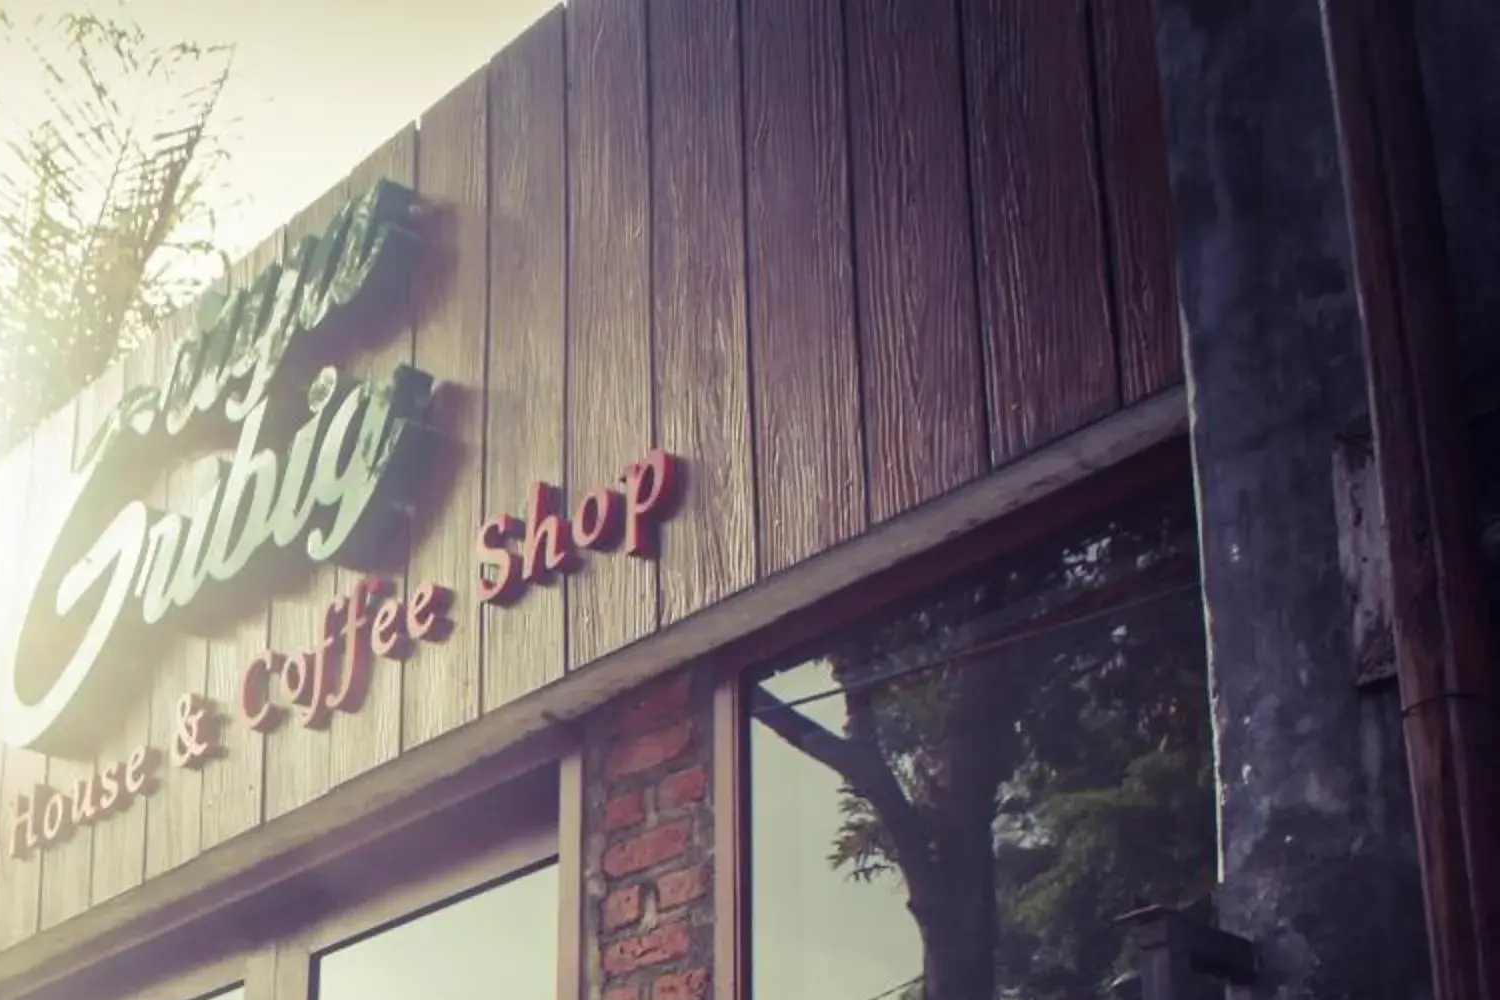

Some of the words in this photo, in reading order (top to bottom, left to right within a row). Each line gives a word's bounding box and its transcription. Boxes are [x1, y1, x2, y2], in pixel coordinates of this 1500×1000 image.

[8, 744, 150, 860] House
[169, 692, 208, 768] &
[241, 574, 442, 730] Coffee
[477, 447, 678, 604] Shop
